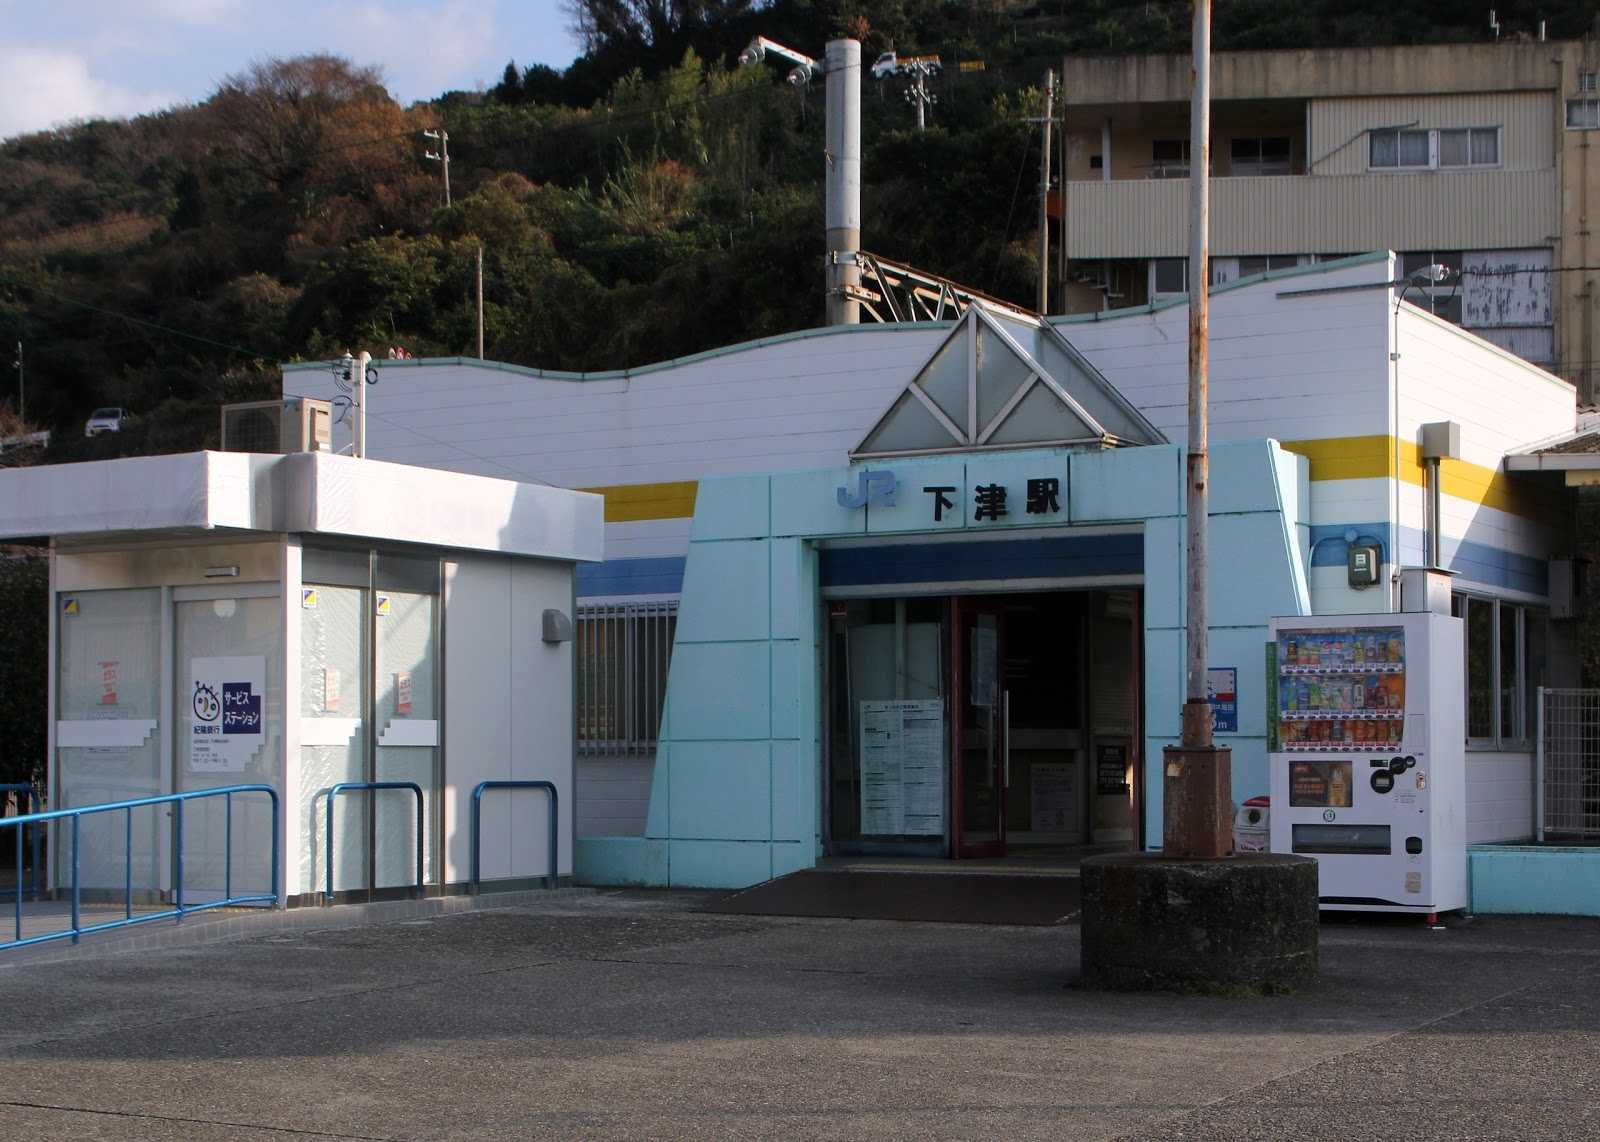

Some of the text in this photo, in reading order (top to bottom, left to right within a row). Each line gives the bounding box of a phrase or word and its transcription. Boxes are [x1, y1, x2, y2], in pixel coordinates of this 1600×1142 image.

[837, 470, 1060, 522] JR 下津駅
[224, 691, 249, 705] サービス
[224, 711, 259, 726] ステーション
